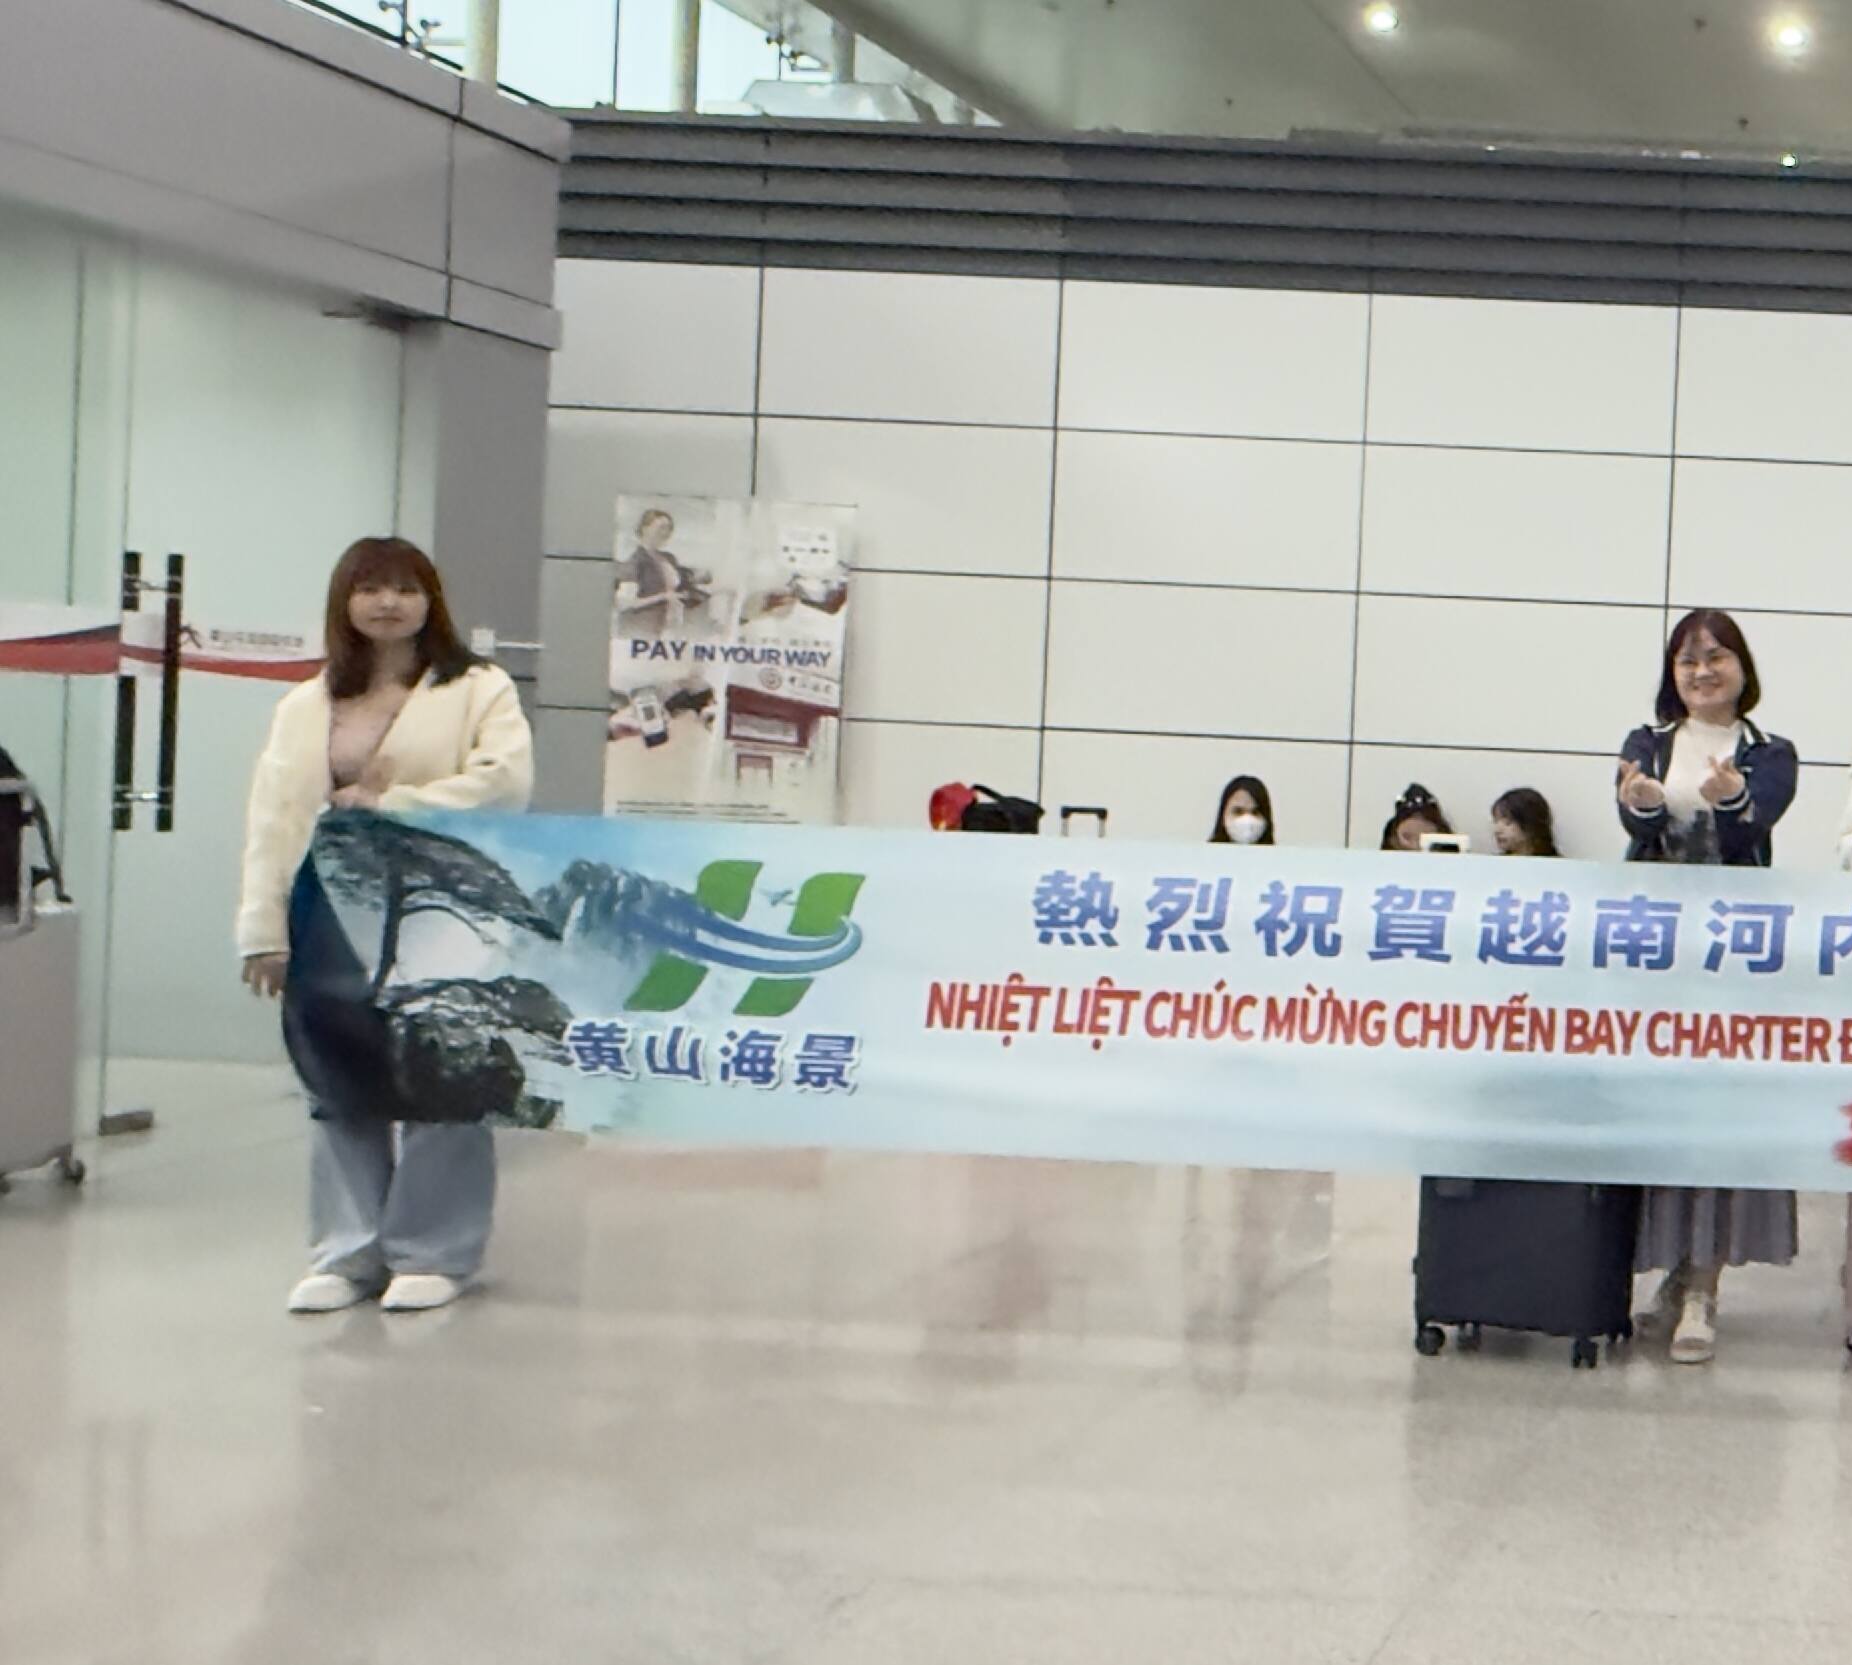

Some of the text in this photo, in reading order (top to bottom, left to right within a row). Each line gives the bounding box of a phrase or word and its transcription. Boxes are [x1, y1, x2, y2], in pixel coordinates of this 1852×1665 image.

[630, 639, 831, 667] PAY IN YOUR WAY
[926, 972, 1051, 1047] NHIỆT
[1053, 976, 1142, 1050] LIỆT
[1145, 979, 1259, 1040] CHÚC
[1262, 983, 1387, 1047] MỪNG
[1394, 992, 1557, 1052] CHUYẾN
[1564, 1008, 1641, 1056] BAY
[1646, 1011, 1832, 1063] CHARTER
